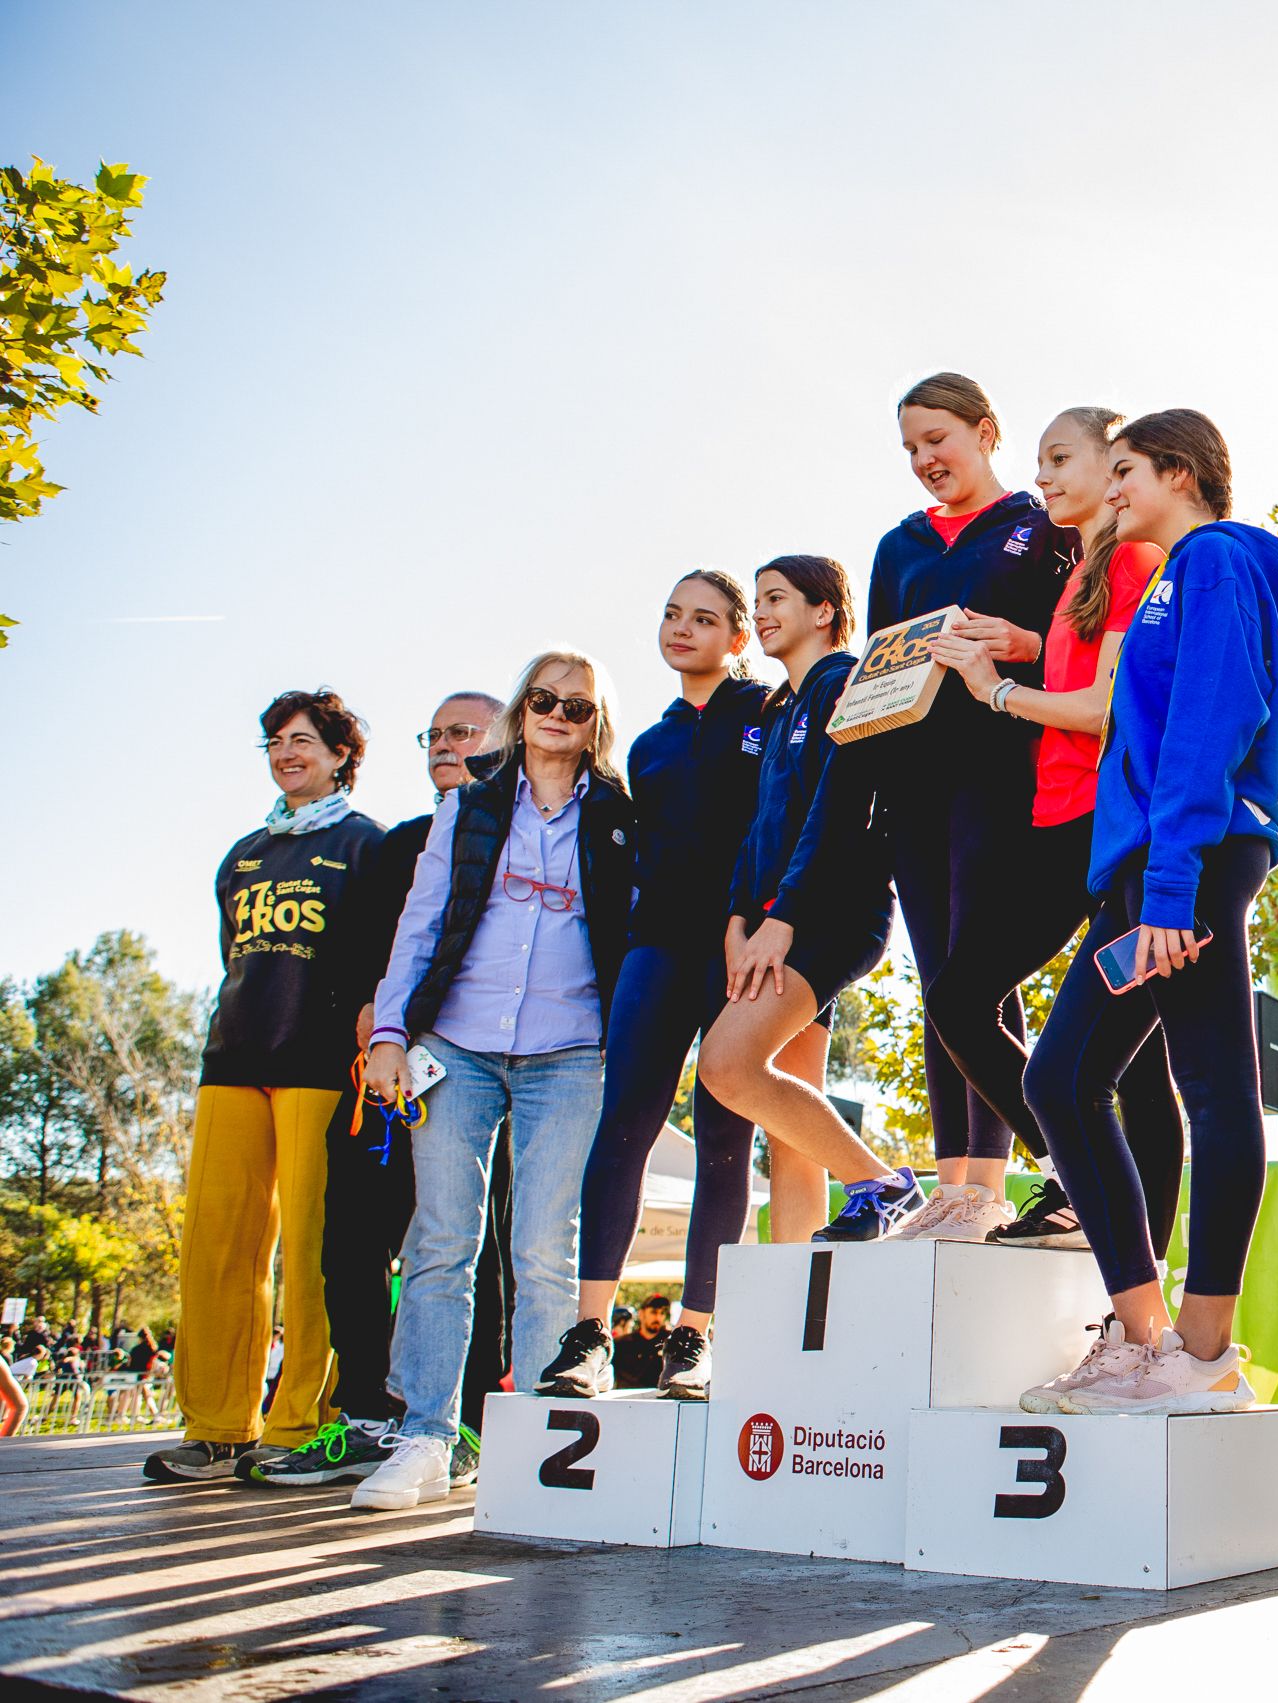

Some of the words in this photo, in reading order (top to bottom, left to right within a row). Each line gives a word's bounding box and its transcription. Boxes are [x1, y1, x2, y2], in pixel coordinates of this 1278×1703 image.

[275, 887, 295, 896] Sant
[295, 886, 321, 894] Cugat
[302, 878, 314, 886] de
[235, 900, 326, 943] CROS
[667, 1224, 686, 1237] San
[538, 1409, 600, 1491] 2
[792, 1426, 886, 1452] Diputació
[791, 1454, 885, 1480] Barcelona
[993, 1426, 1067, 1519] 3
